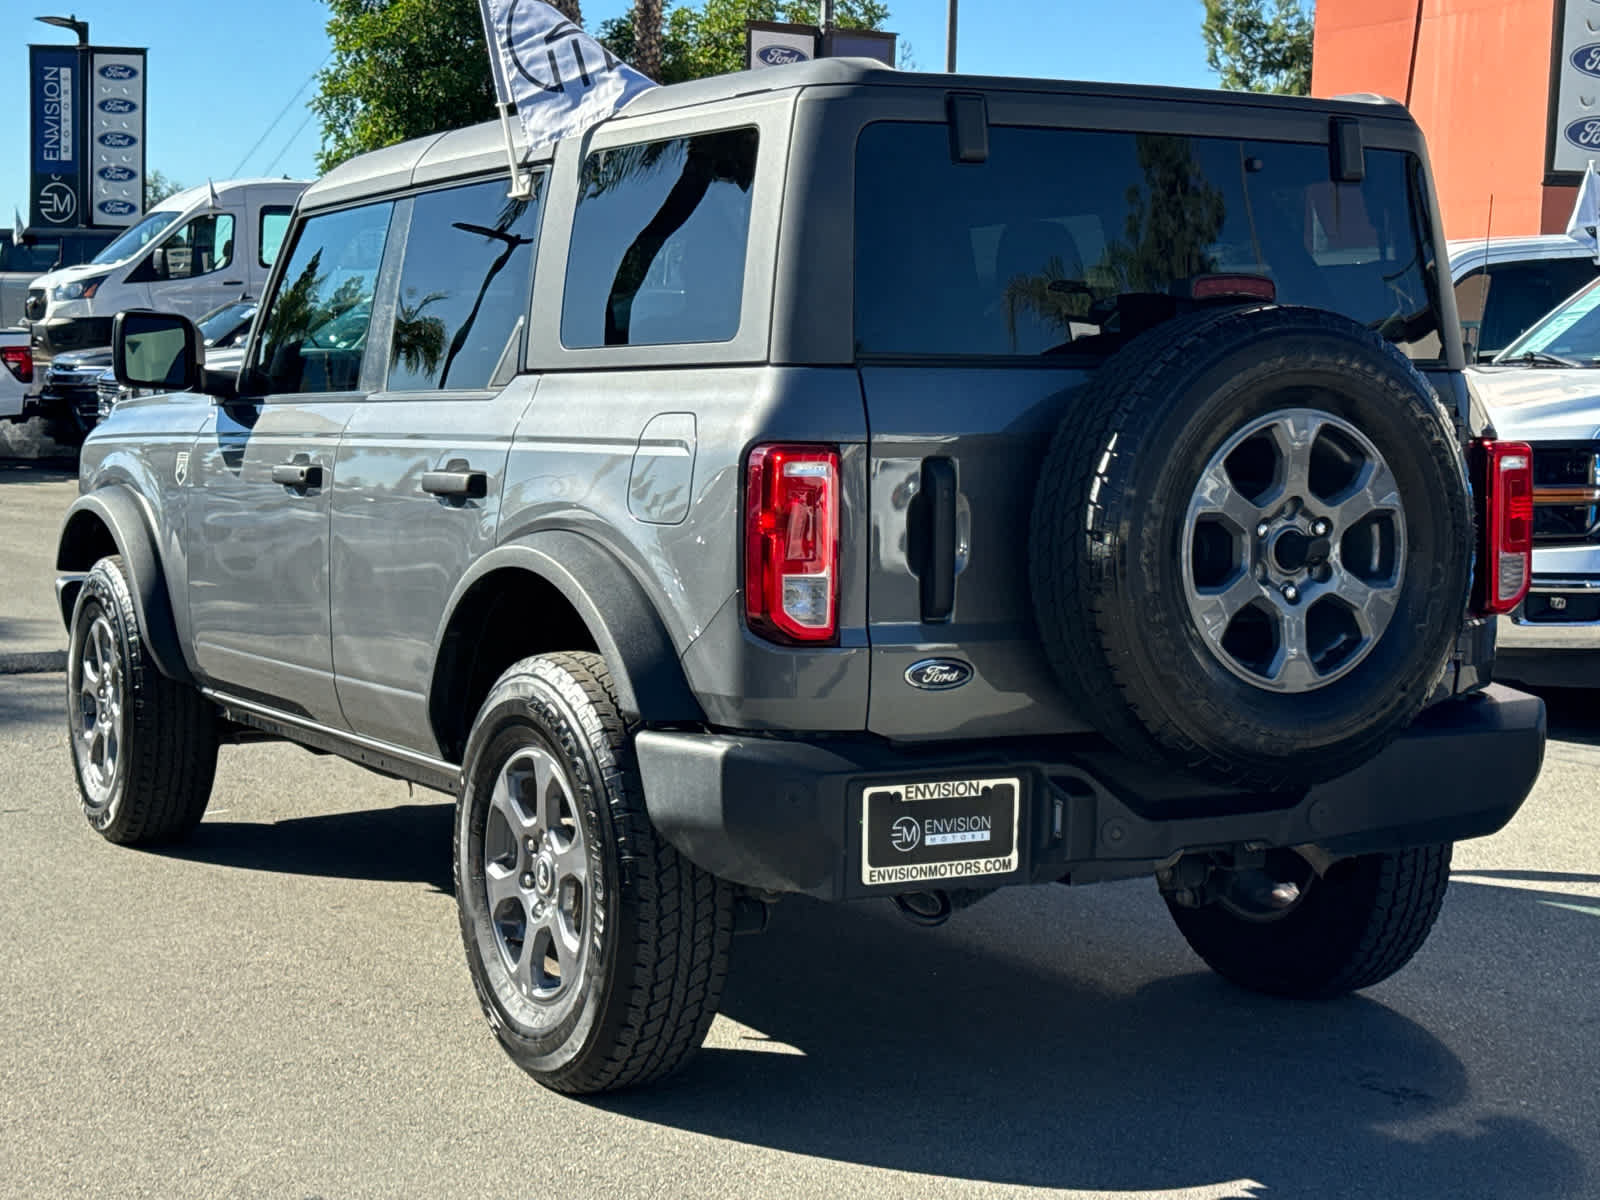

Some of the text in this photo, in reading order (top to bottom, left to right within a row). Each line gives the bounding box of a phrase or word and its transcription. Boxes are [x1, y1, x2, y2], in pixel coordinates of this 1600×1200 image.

[766, 48, 799, 65] Ford
[105, 66, 130, 79] Ford
[43, 66, 60, 161] ENVISION
[104, 100, 130, 112] Ford
[104, 134, 130, 147] Ford
[104, 168, 130, 180] Ford
[104, 202, 130, 214] Ford
[922, 665, 960, 683] Ford
[905, 781, 980, 800] ENVISION
[924, 815, 992, 834] ENVISION
[929, 833, 985, 844] MOTORS
[869, 858, 1012, 883] ENVISIONMOTORS.COM
